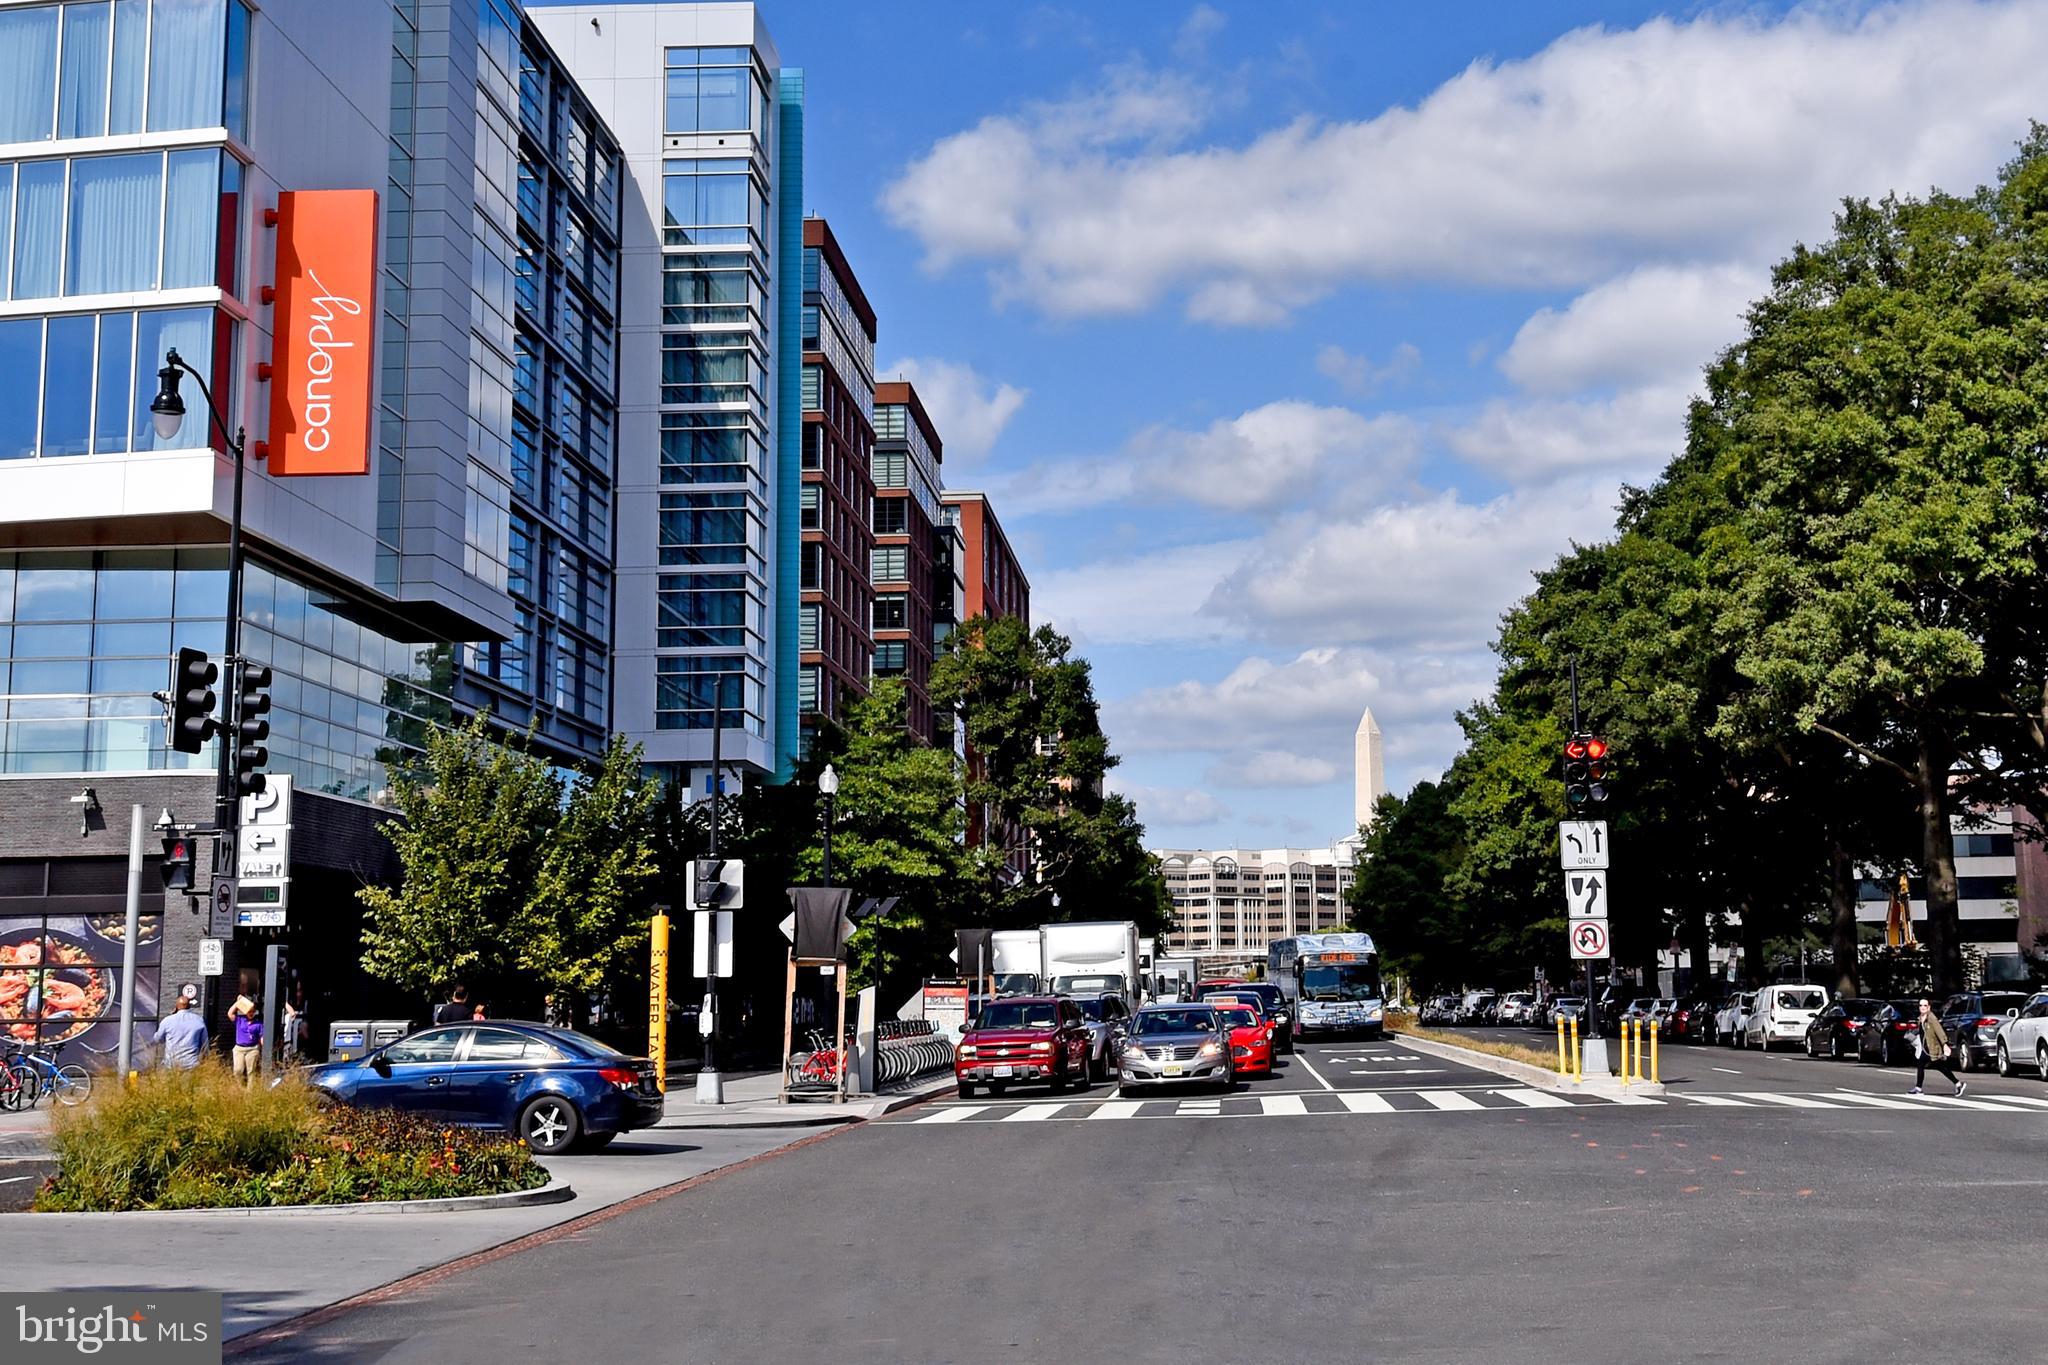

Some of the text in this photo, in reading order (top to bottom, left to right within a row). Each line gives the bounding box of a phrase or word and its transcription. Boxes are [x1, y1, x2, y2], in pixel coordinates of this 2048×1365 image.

[304, 268, 361, 453] canopy
[239, 862, 282, 877] VALET
[1577, 857, 1597, 865] ONLY
[650, 963, 659, 1024] WATER
